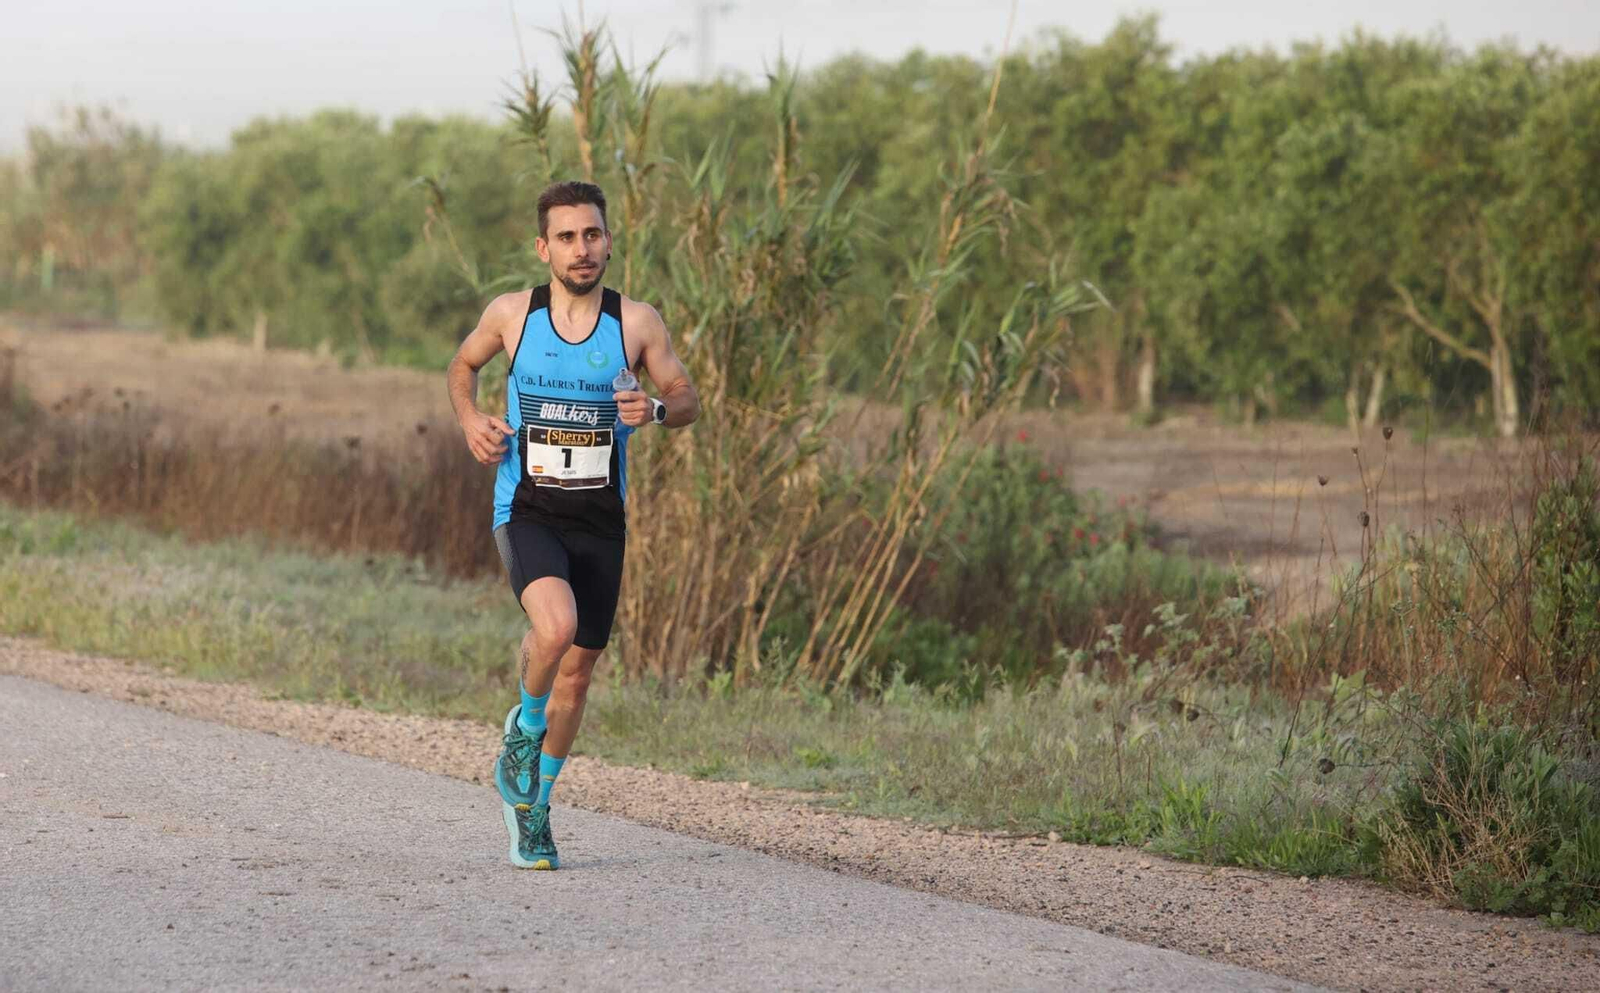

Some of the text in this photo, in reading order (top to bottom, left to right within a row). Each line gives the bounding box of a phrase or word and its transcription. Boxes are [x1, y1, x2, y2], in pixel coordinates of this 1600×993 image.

[521, 376, 536, 386] C.D.
[539, 375, 575, 390] LAURUS
[551, 430, 591, 444] Sherry
[561, 448, 572, 469] 1
